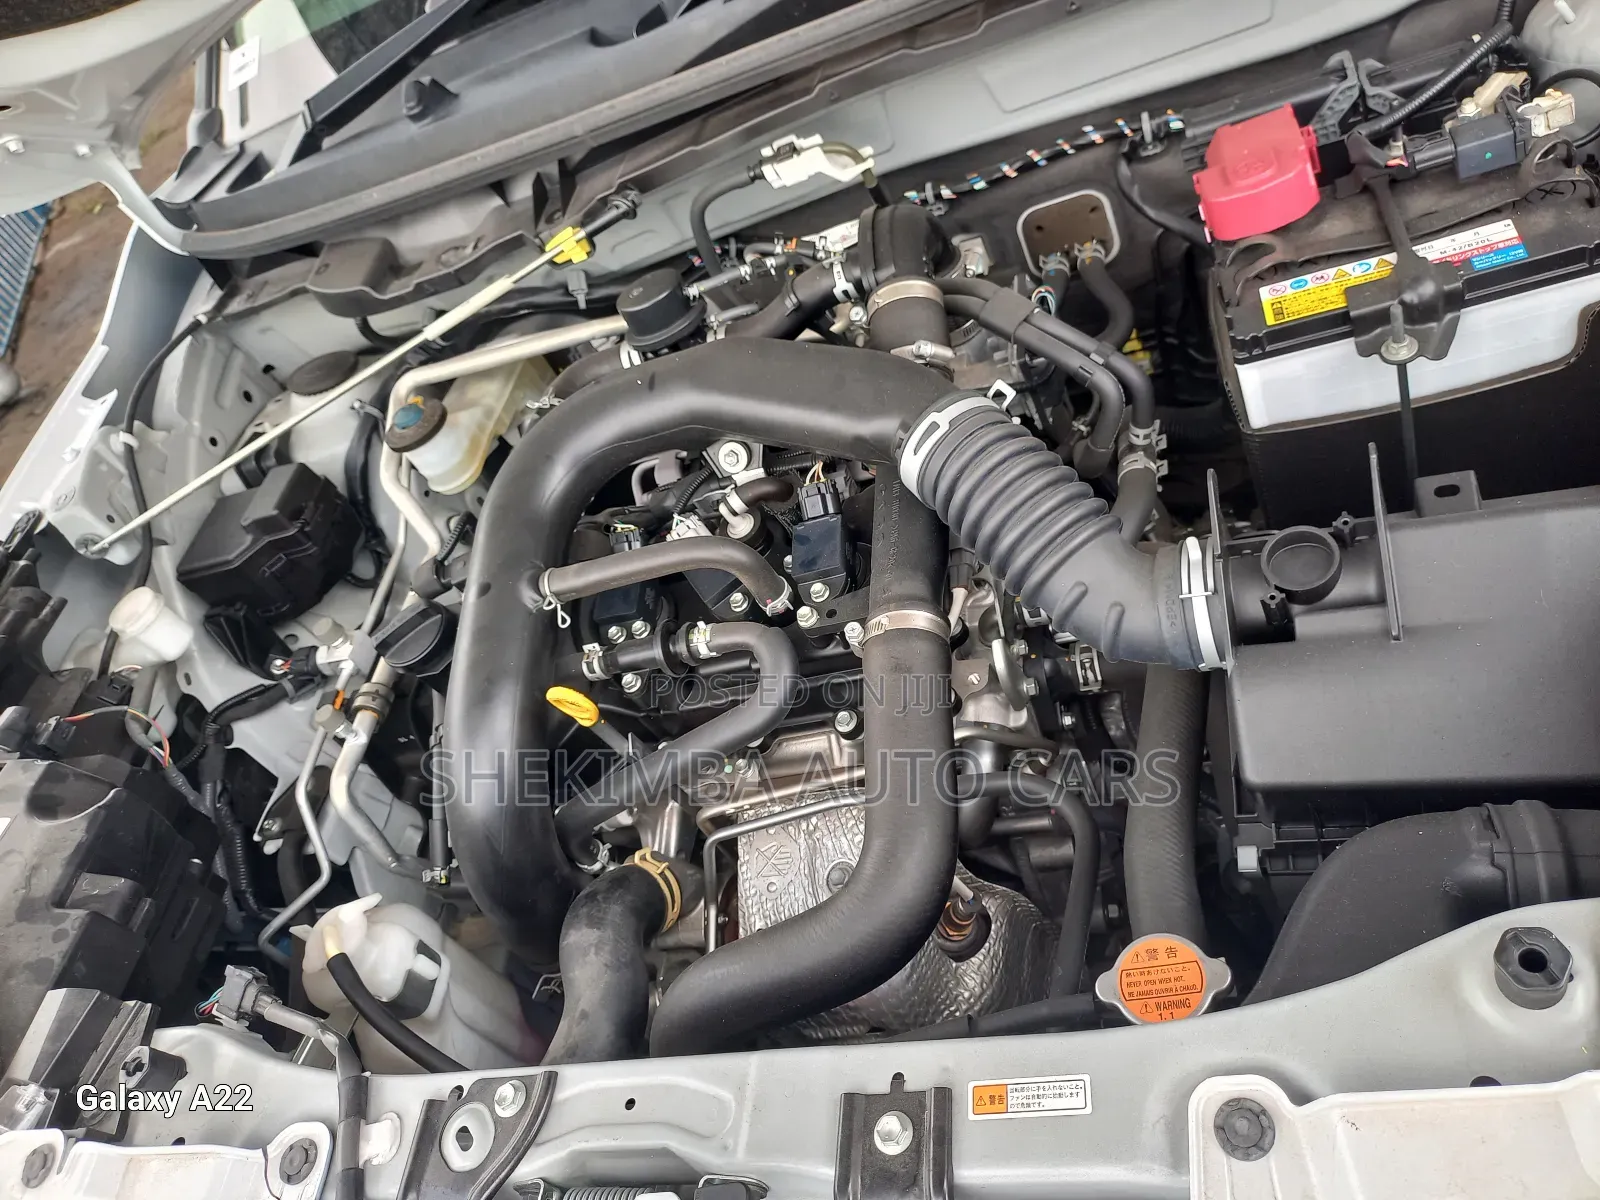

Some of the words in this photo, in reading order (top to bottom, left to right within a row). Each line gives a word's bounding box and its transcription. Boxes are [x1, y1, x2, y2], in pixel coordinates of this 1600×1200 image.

[1145, 945, 1178, 962] 警告
[1126, 980, 1142, 988] NEVER
[1143, 979, 1156, 987] OPEN
[1157, 977, 1172, 985] WHEN
[1154, 998, 1191, 1011] WARNING
[988, 1093, 1006, 1106] 警告
